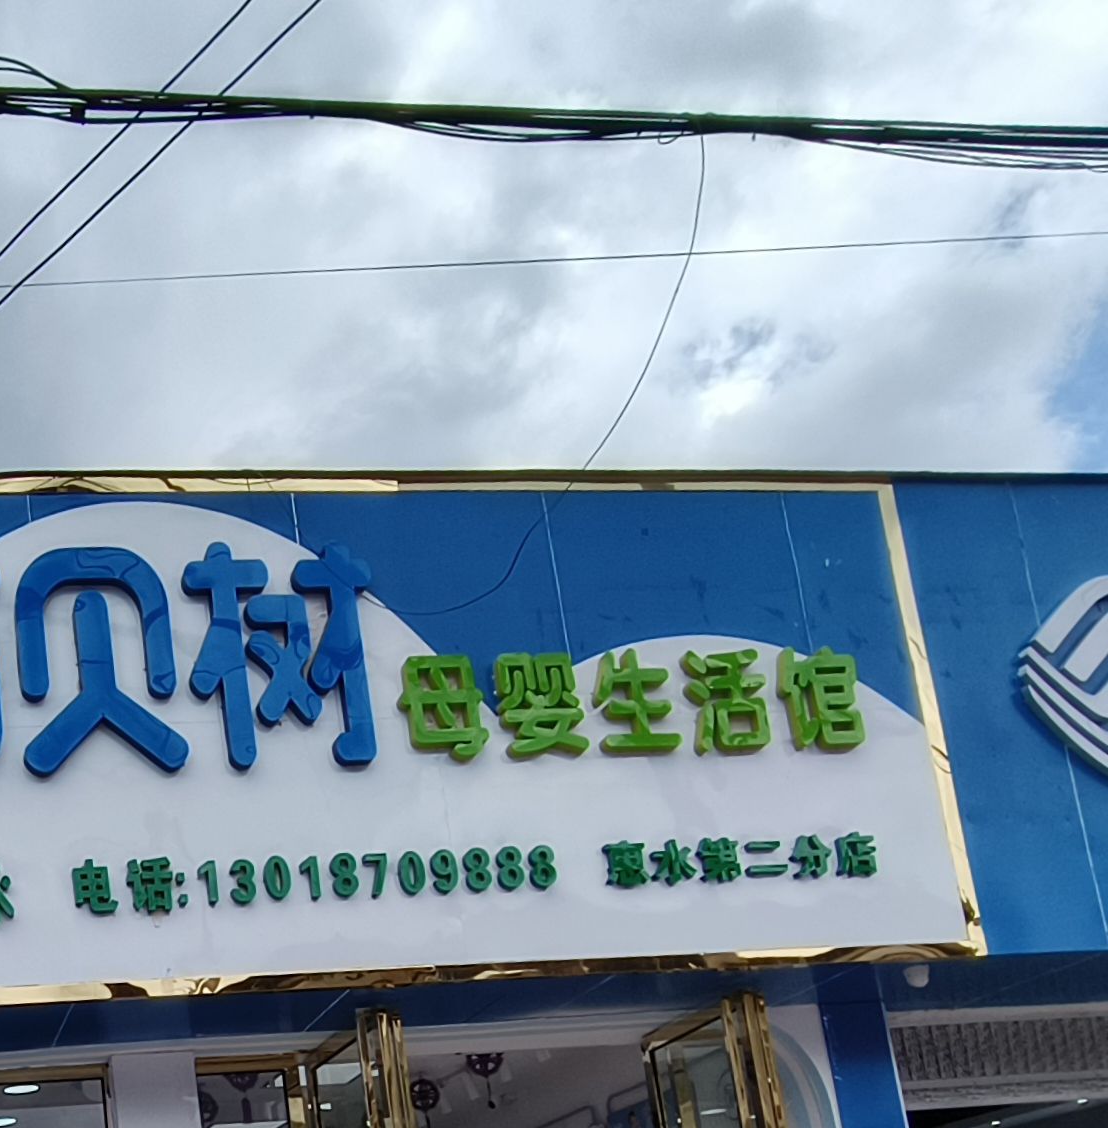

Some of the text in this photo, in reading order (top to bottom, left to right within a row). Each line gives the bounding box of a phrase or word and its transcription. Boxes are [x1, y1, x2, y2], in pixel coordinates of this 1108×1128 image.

[397, 644, 866, 762] 母婴生活馆
[601, 831, 878, 888] 惠水第二分店
